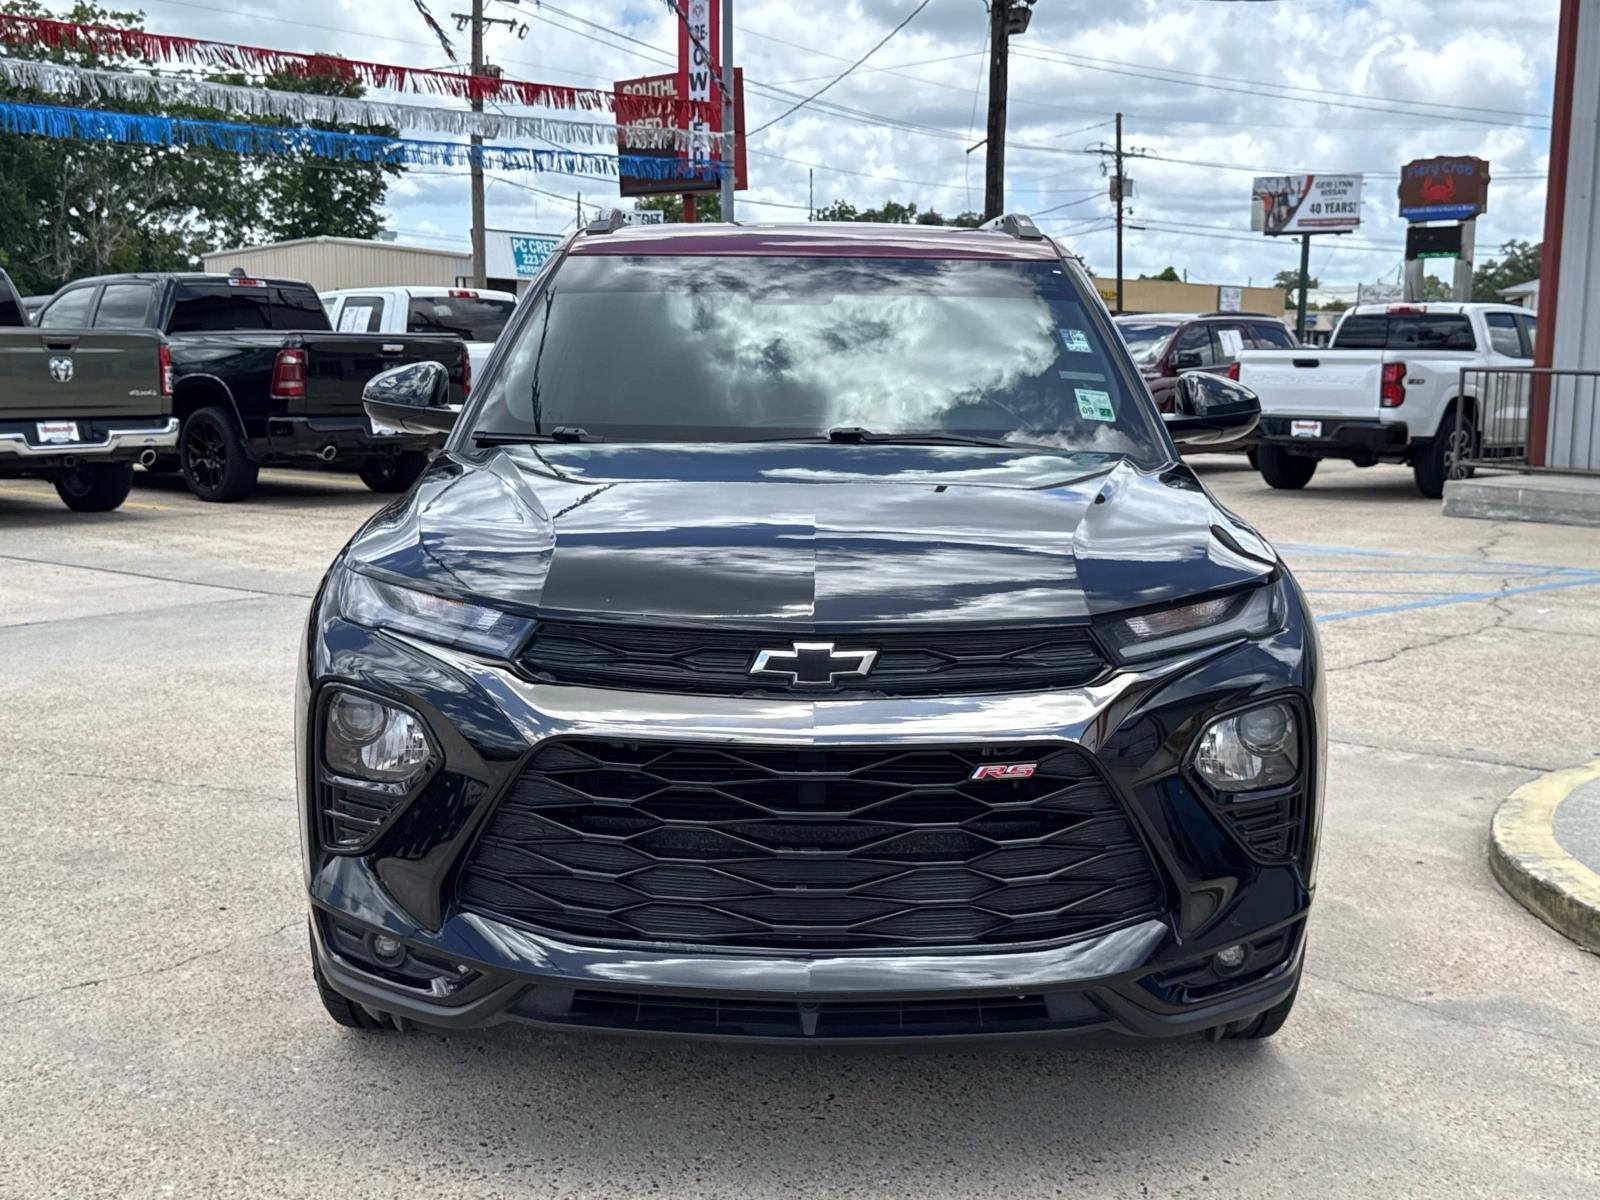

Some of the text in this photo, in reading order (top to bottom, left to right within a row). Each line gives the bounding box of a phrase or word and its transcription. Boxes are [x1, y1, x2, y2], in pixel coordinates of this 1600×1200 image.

[1334, 180, 1354, 188] LYNN
[1309, 202, 1357, 214] 40 YEARS!
[512, 239, 527, 253] PC
[1082, 406, 1095, 416] 09
[971, 764, 1037, 779] RS
